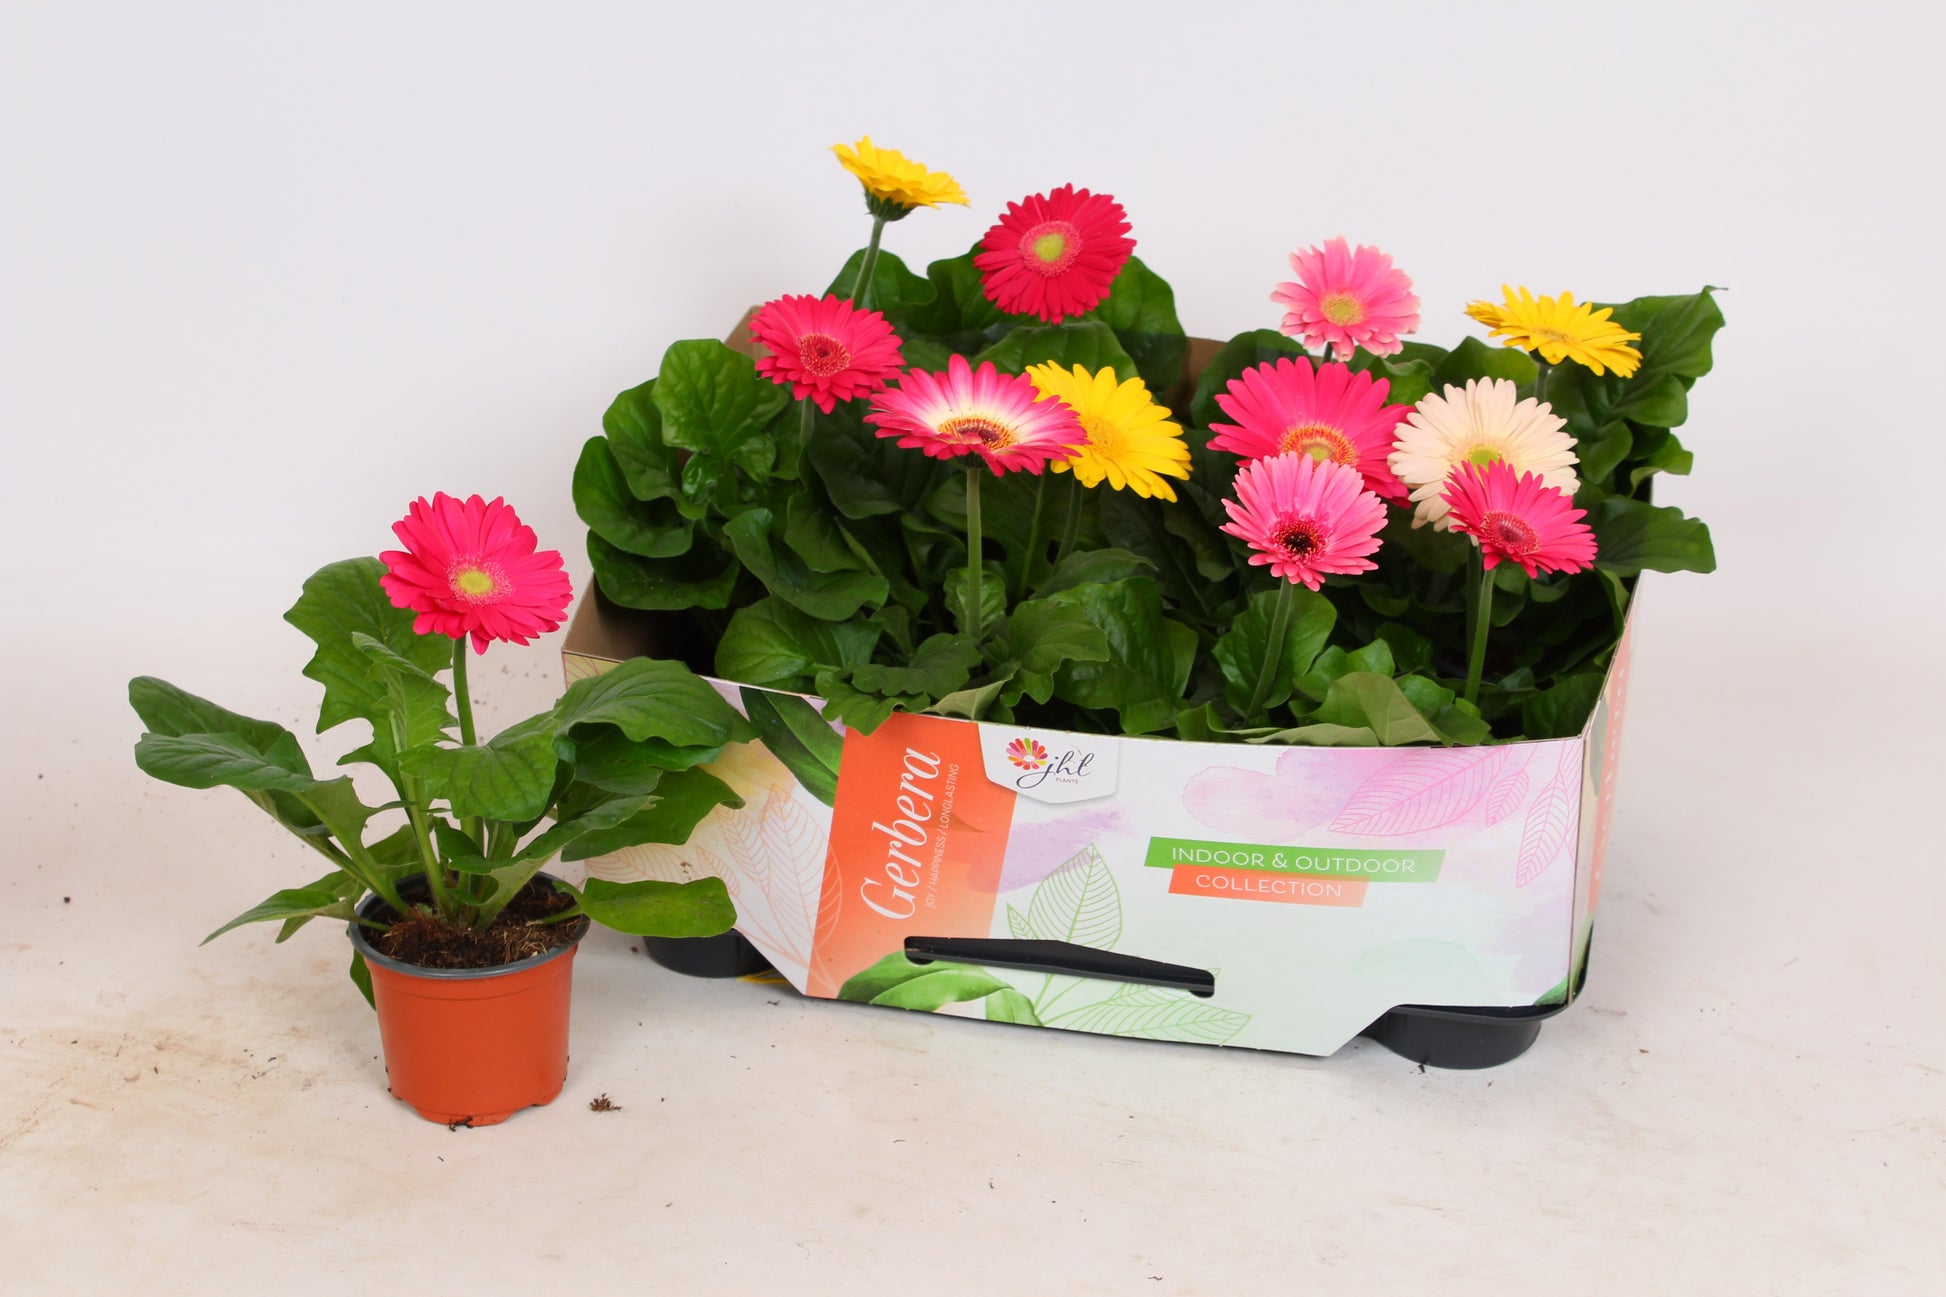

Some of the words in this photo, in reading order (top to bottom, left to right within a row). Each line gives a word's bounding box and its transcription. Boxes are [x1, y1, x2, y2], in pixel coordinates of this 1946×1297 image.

[1016, 750, 1095, 789] jhl
[1055, 777, 1079, 785] PLANTS
[940, 763, 960, 829] LONGLASTING
[860, 747, 941, 919] Gerbera
[929, 835, 946, 885] HAPPINESS
[1172, 847, 1265, 868] INDOOR
[1272, 853, 1288, 868] &
[1295, 856, 1415, 874] OUTDOOR
[924, 891, 936, 909] JOY
[1195, 874, 1342, 897] COLLECTION
